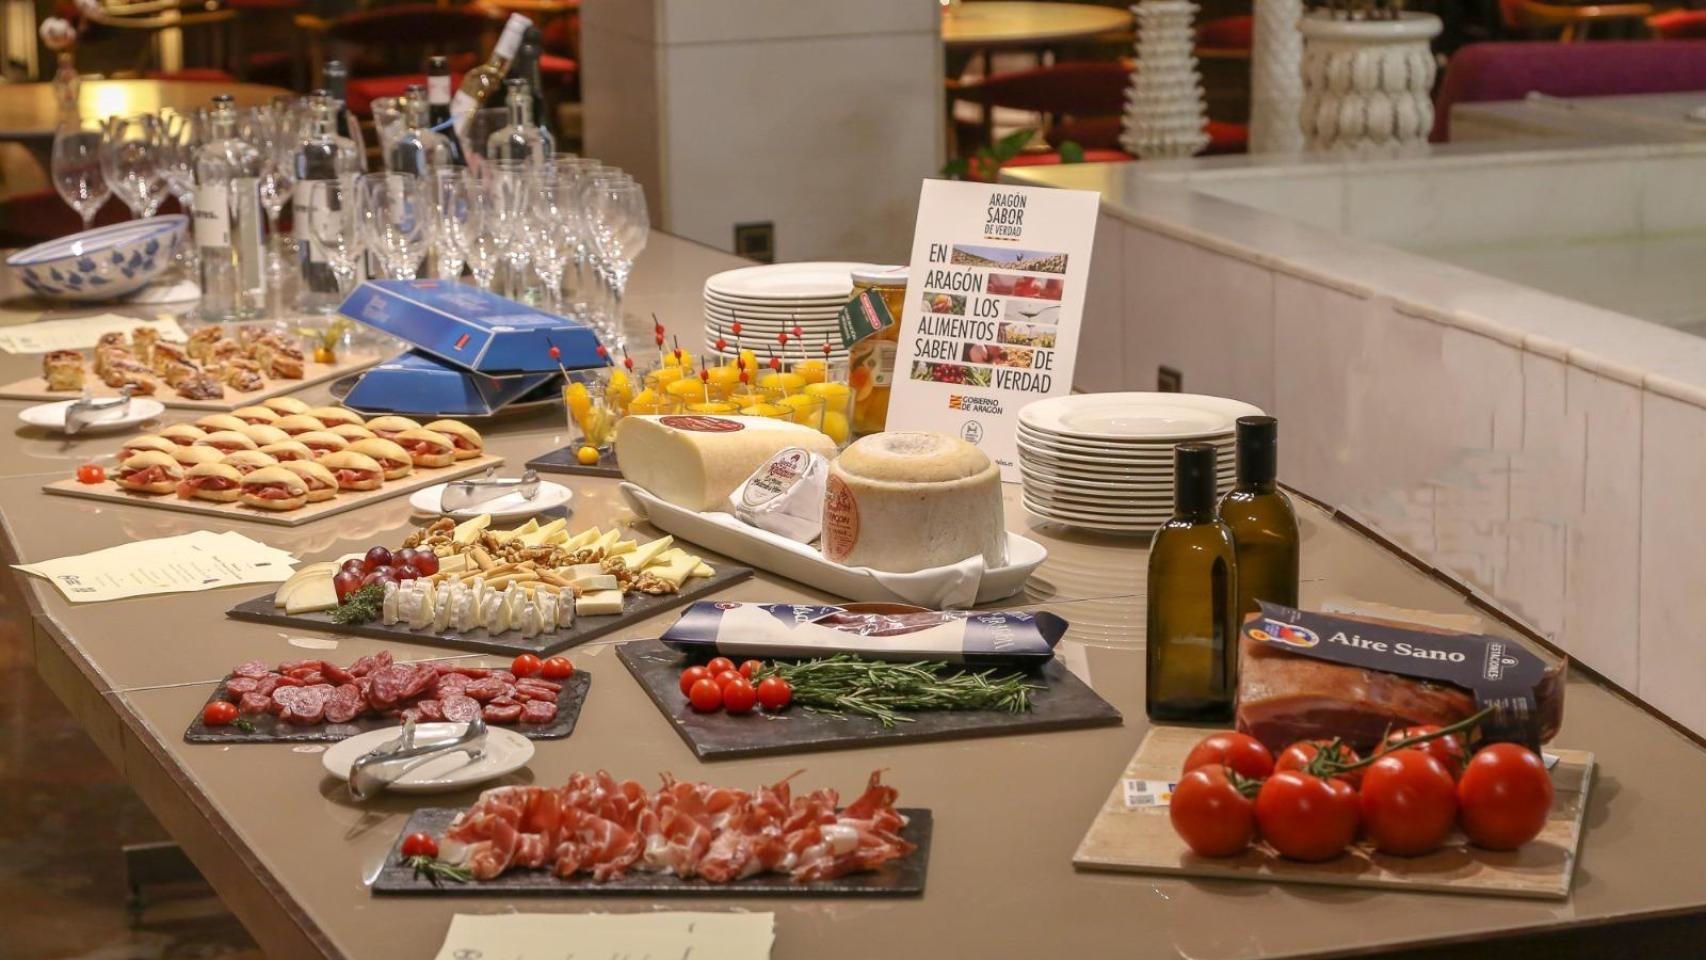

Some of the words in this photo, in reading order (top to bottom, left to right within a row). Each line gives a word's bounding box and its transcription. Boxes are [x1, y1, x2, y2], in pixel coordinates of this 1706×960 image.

[989, 192, 1027, 208] ARAGÓN
[986, 207, 1024, 225] SABOR
[984, 224, 994, 235] DE
[995, 225, 1022, 237] VERDAD
[929, 243, 948, 263] EN
[924, 267, 983, 293] ARAGÓN
[973, 299, 1000, 318] LOS
[917, 315, 995, 341] ALIMENTOS
[914, 338, 959, 361] SABEN
[1034, 350, 1055, 371] DE
[996, 369, 1052, 394] VERDAD
[961, 403, 971, 411] DE
[962, 396, 999, 406] GOBIERNO
[1327, 631, 1389, 653] Aire
[1394, 642, 1466, 664] Sano
